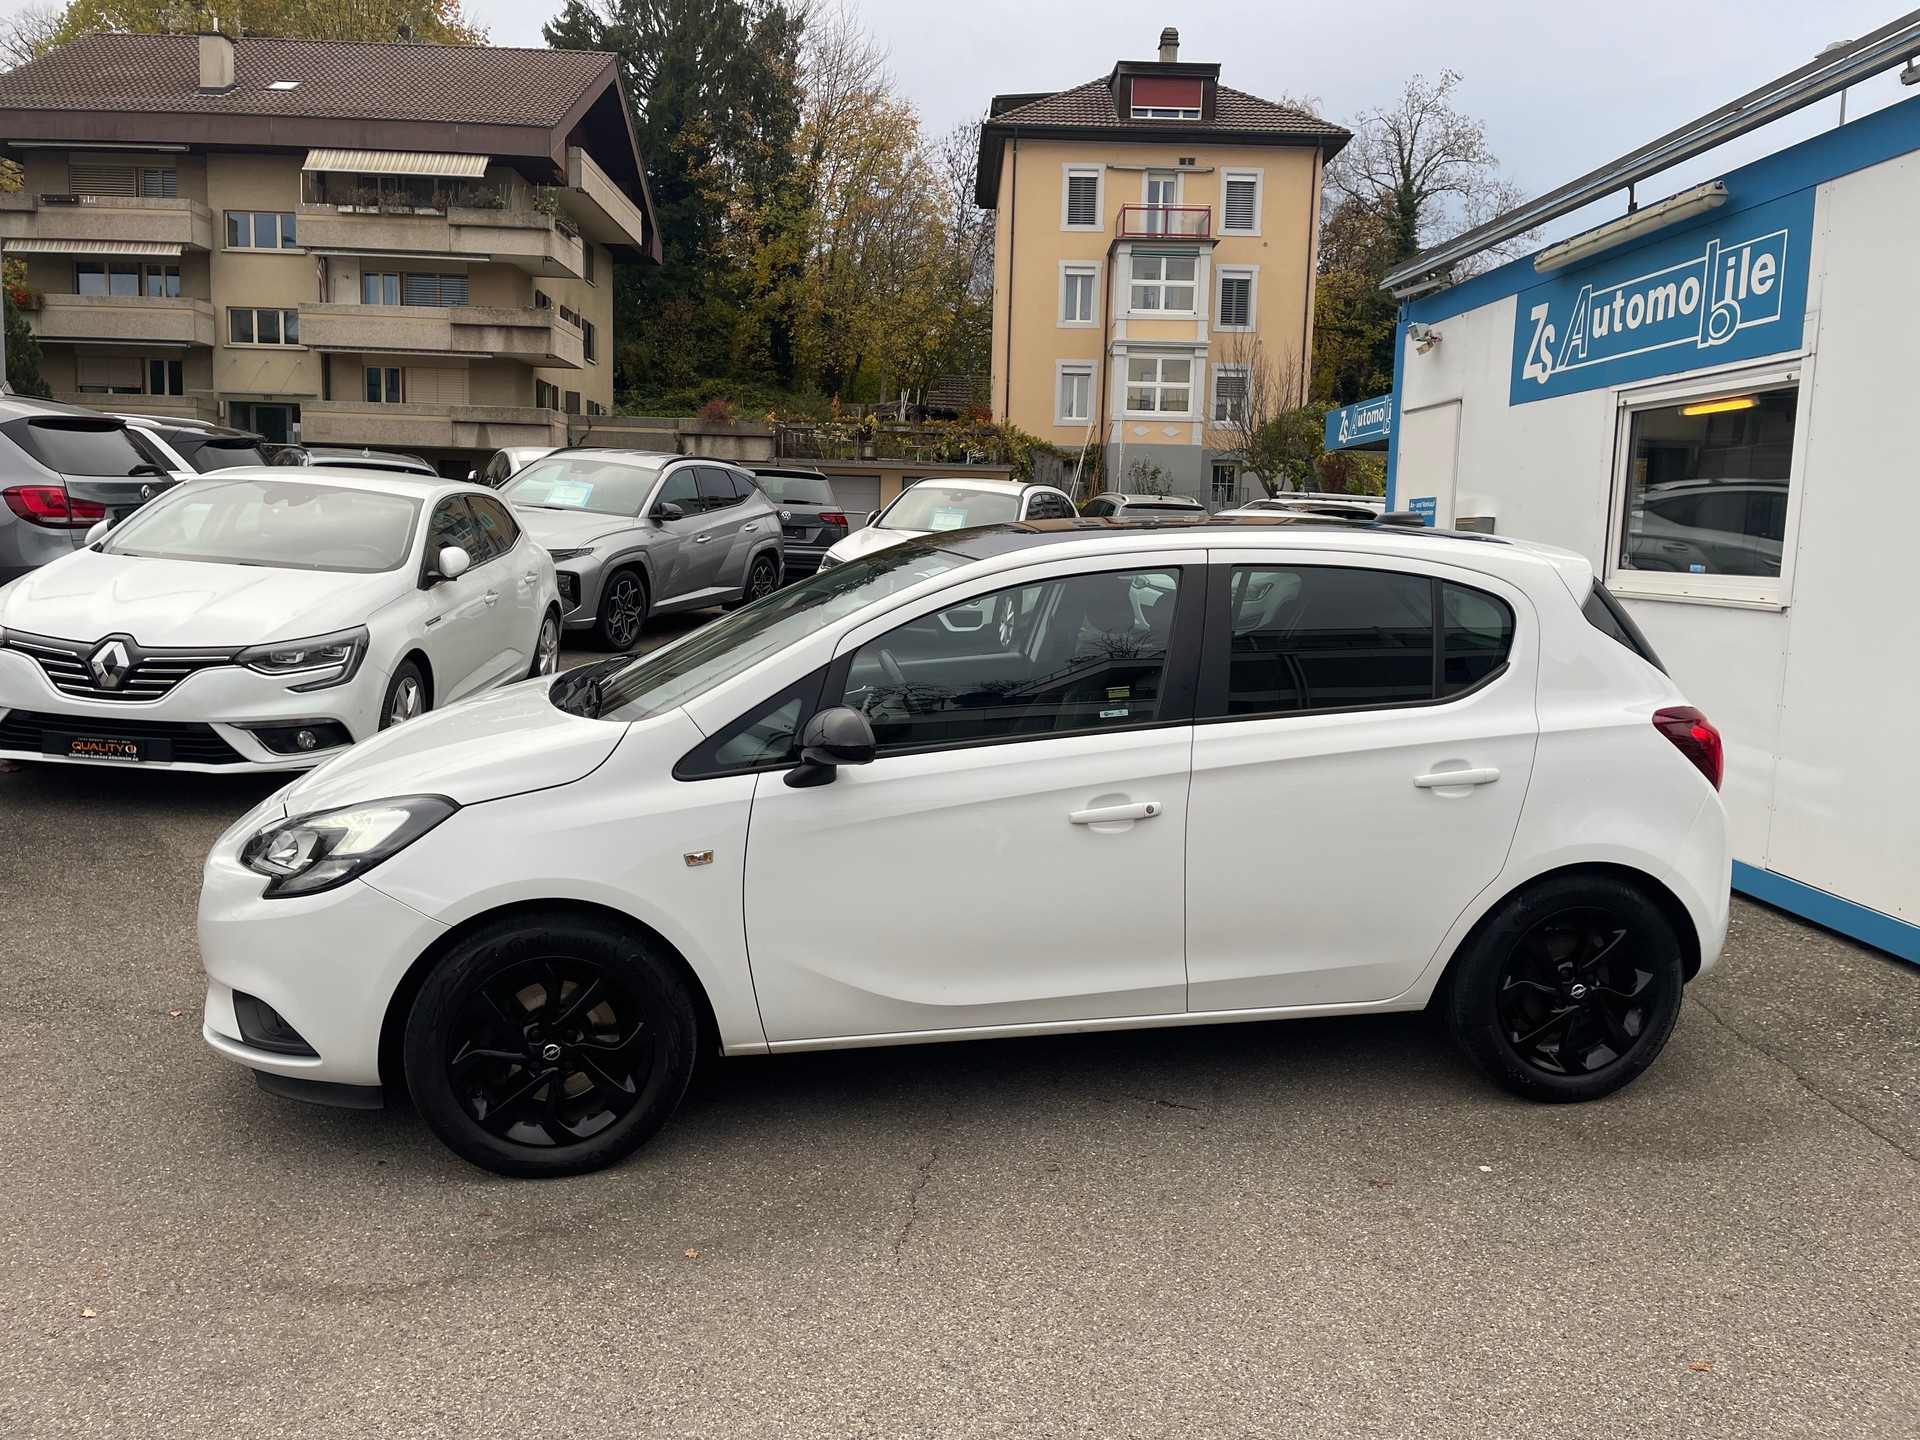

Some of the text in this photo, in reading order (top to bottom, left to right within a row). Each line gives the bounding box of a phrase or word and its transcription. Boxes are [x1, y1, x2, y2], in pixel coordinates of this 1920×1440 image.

[1522, 238, 1776, 384] Zs Automobile
[1349, 395, 1392, 437] Automobi
[71, 741, 124, 752] QUALITY
